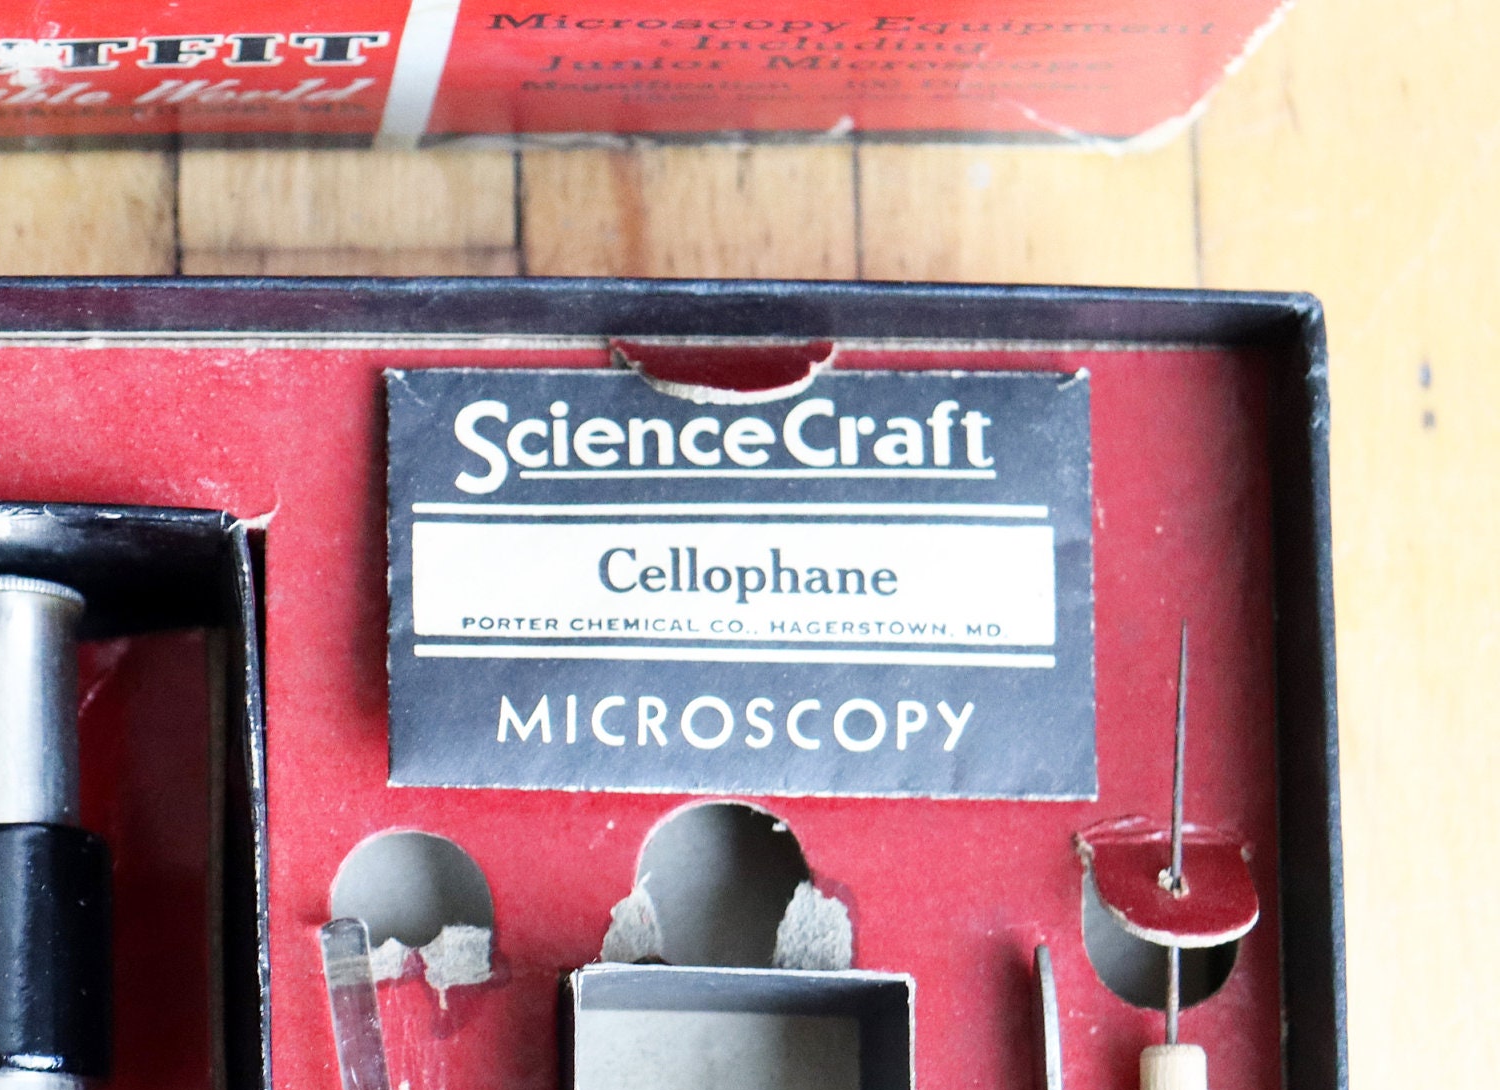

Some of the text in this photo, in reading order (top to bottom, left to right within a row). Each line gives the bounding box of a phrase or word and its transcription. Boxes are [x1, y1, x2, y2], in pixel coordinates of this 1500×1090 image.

[485, 14, 1214, 35] Microscopy Equipment
[691, 35, 988, 54] Including
[539, 55, 1114, 73] Junior Microscope
[134, 79, 375, 104] World
[454, 398, 996, 495] ScienceCraft
[598, 546, 899, 604] Cellophane
[461, 616, 559, 631] PORTER
[570, 617, 701, 634] CHEMICAL
[496, 694, 975, 752] MICROSCOPY
